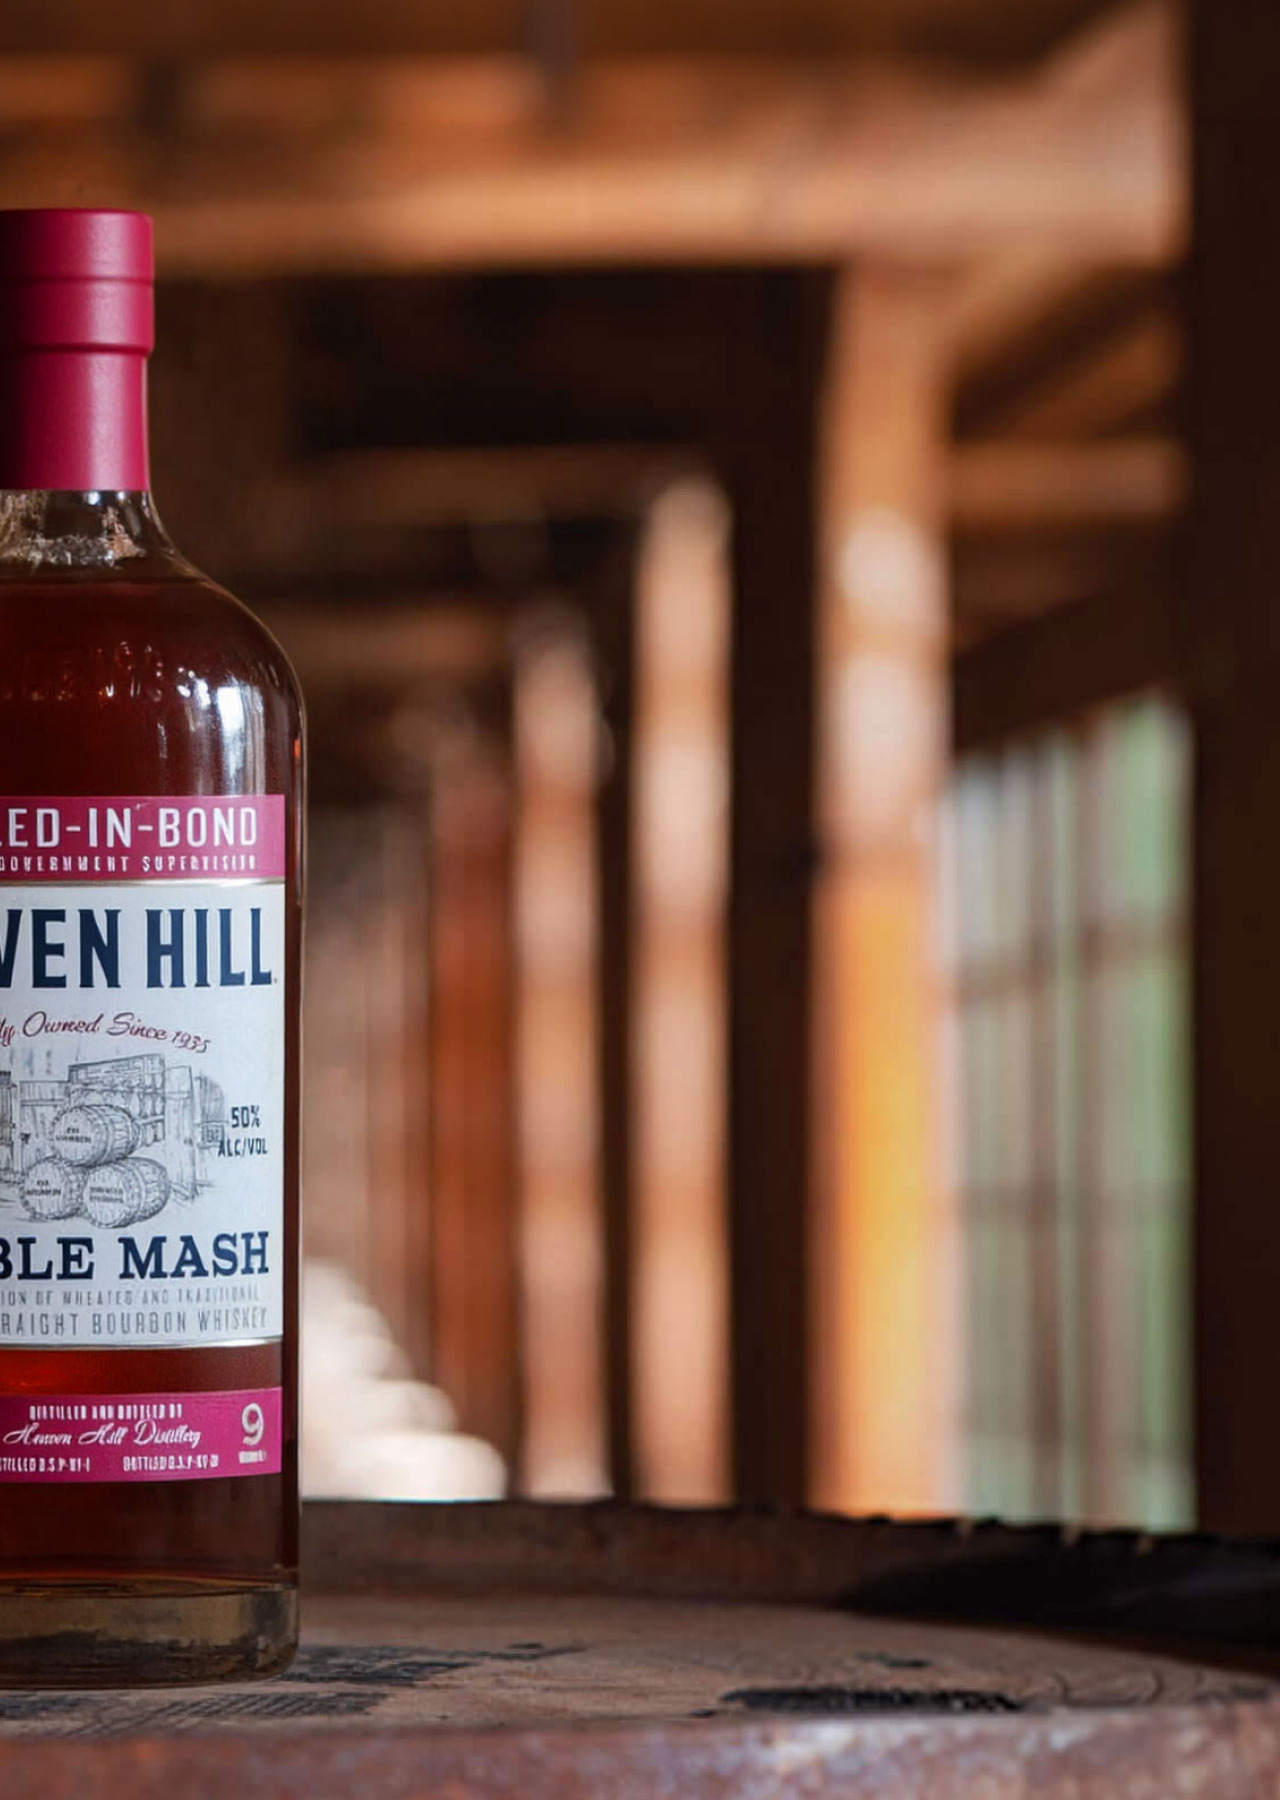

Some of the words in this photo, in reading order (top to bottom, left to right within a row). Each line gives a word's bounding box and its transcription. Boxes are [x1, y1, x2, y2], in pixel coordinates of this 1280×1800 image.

[146, 908, 272, 988] HILL
[22, 1010, 104, 1038] Owned
[106, 1011, 167, 1041] Since
[171, 1030, 212, 1054] 1935
[231, 1104, 260, 1129] 50%
[118, 1230, 269, 1280] MASH
[92, 1311, 187, 1336] BOURBON
[197, 1305, 268, 1333] WHISKEY
[133, 1418, 202, 1449] Distillery
[241, 1402, 265, 1447] 9
